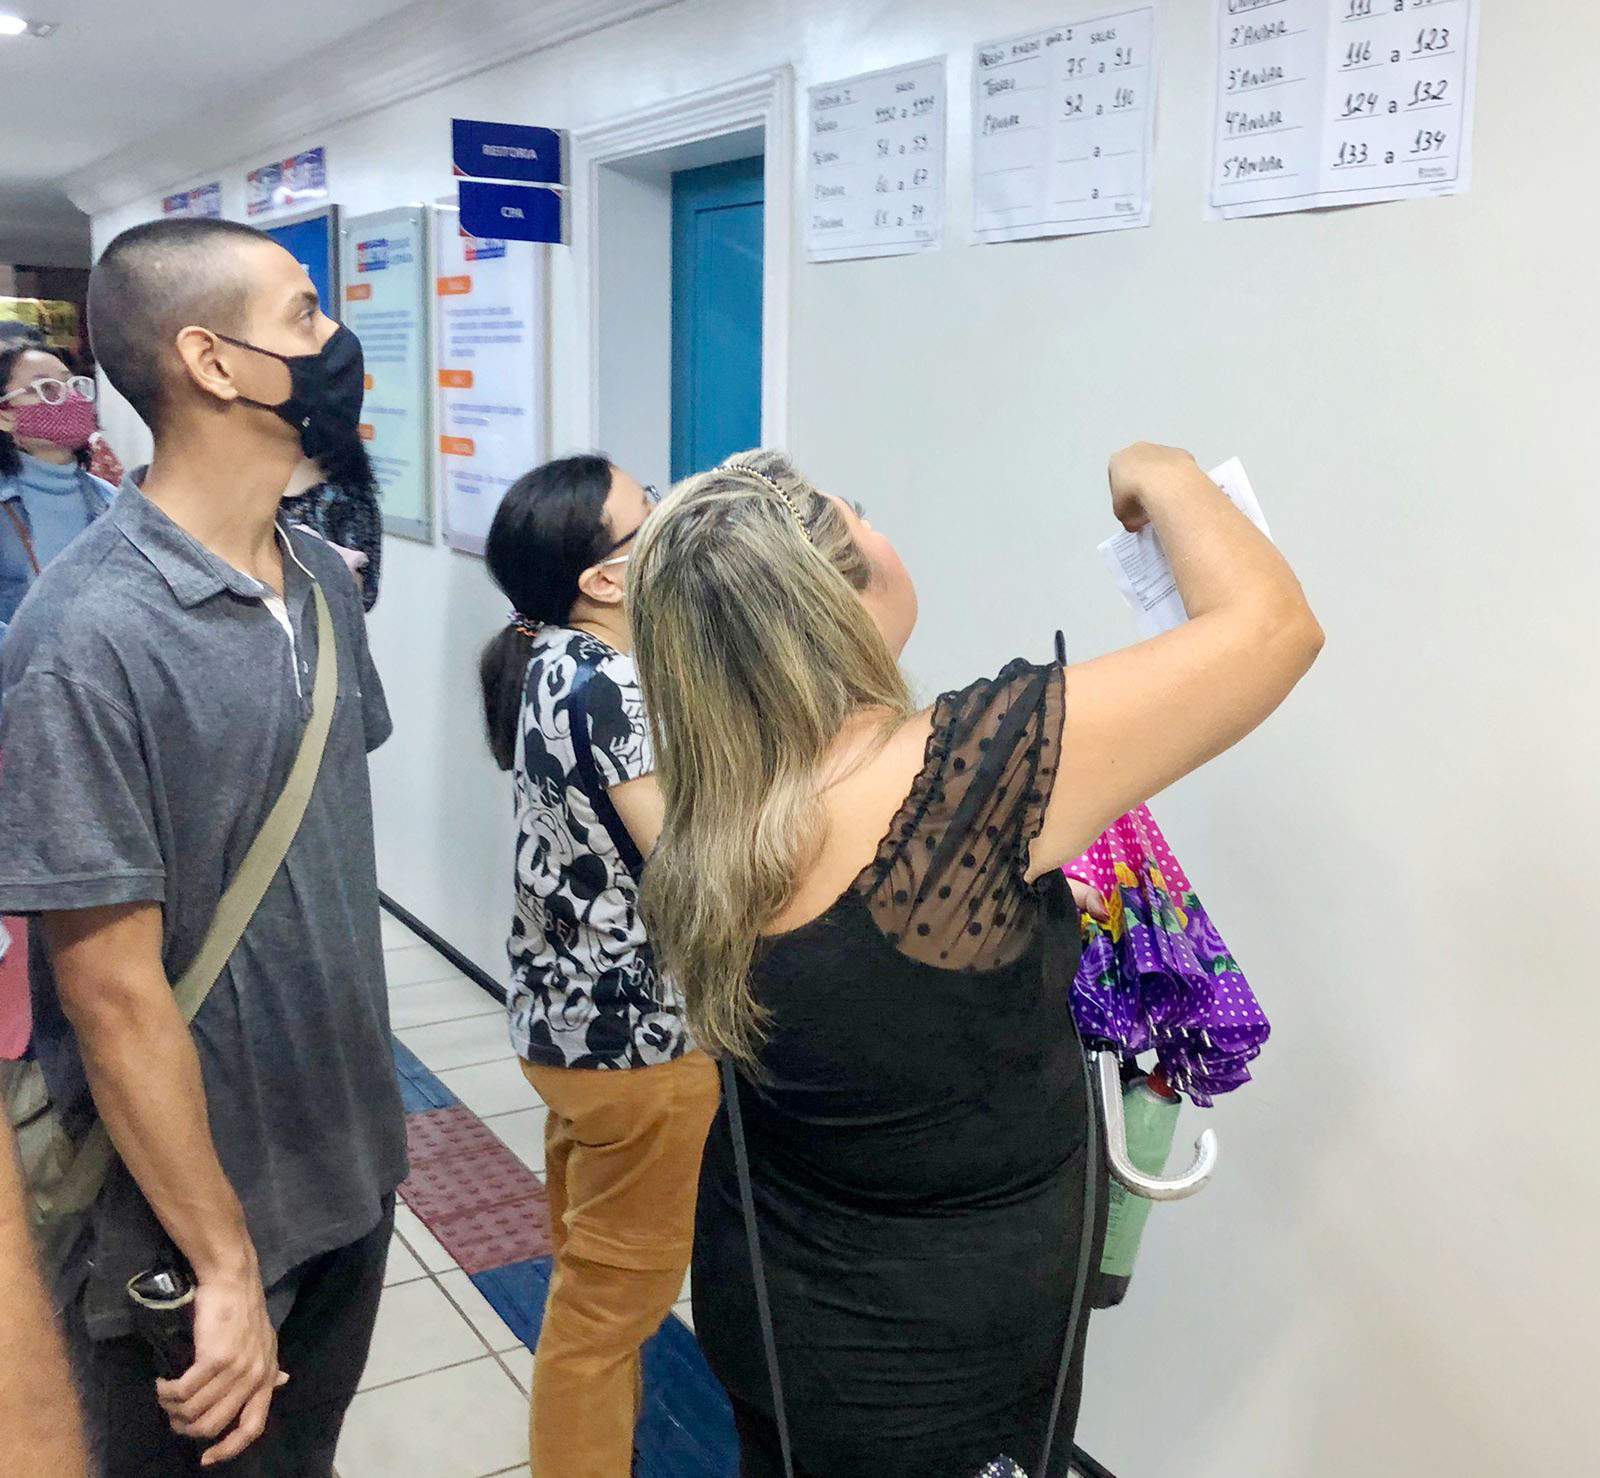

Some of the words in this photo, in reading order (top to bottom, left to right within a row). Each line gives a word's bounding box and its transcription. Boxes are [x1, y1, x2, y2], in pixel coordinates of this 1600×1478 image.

[1393, 0, 1403, 11] a
[1342, 40, 1371, 67] 116
[1391, 50, 1400, 63] a
[1412, 28, 1449, 54] 123
[1067, 57, 1087, 77] 75
[1098, 62, 1106, 74] a
[1341, 92, 1378, 117] 124
[1388, 100, 1397, 114] a
[1408, 79, 1448, 107] 132
[1096, 103, 1104, 116] a
[1093, 146, 1101, 158] a
[1333, 142, 1368, 167] 133
[1384, 151, 1394, 164] a
[1410, 129, 1447, 153] 134
[1091, 188, 1100, 200] a
[501, 206, 525, 219] CPA
